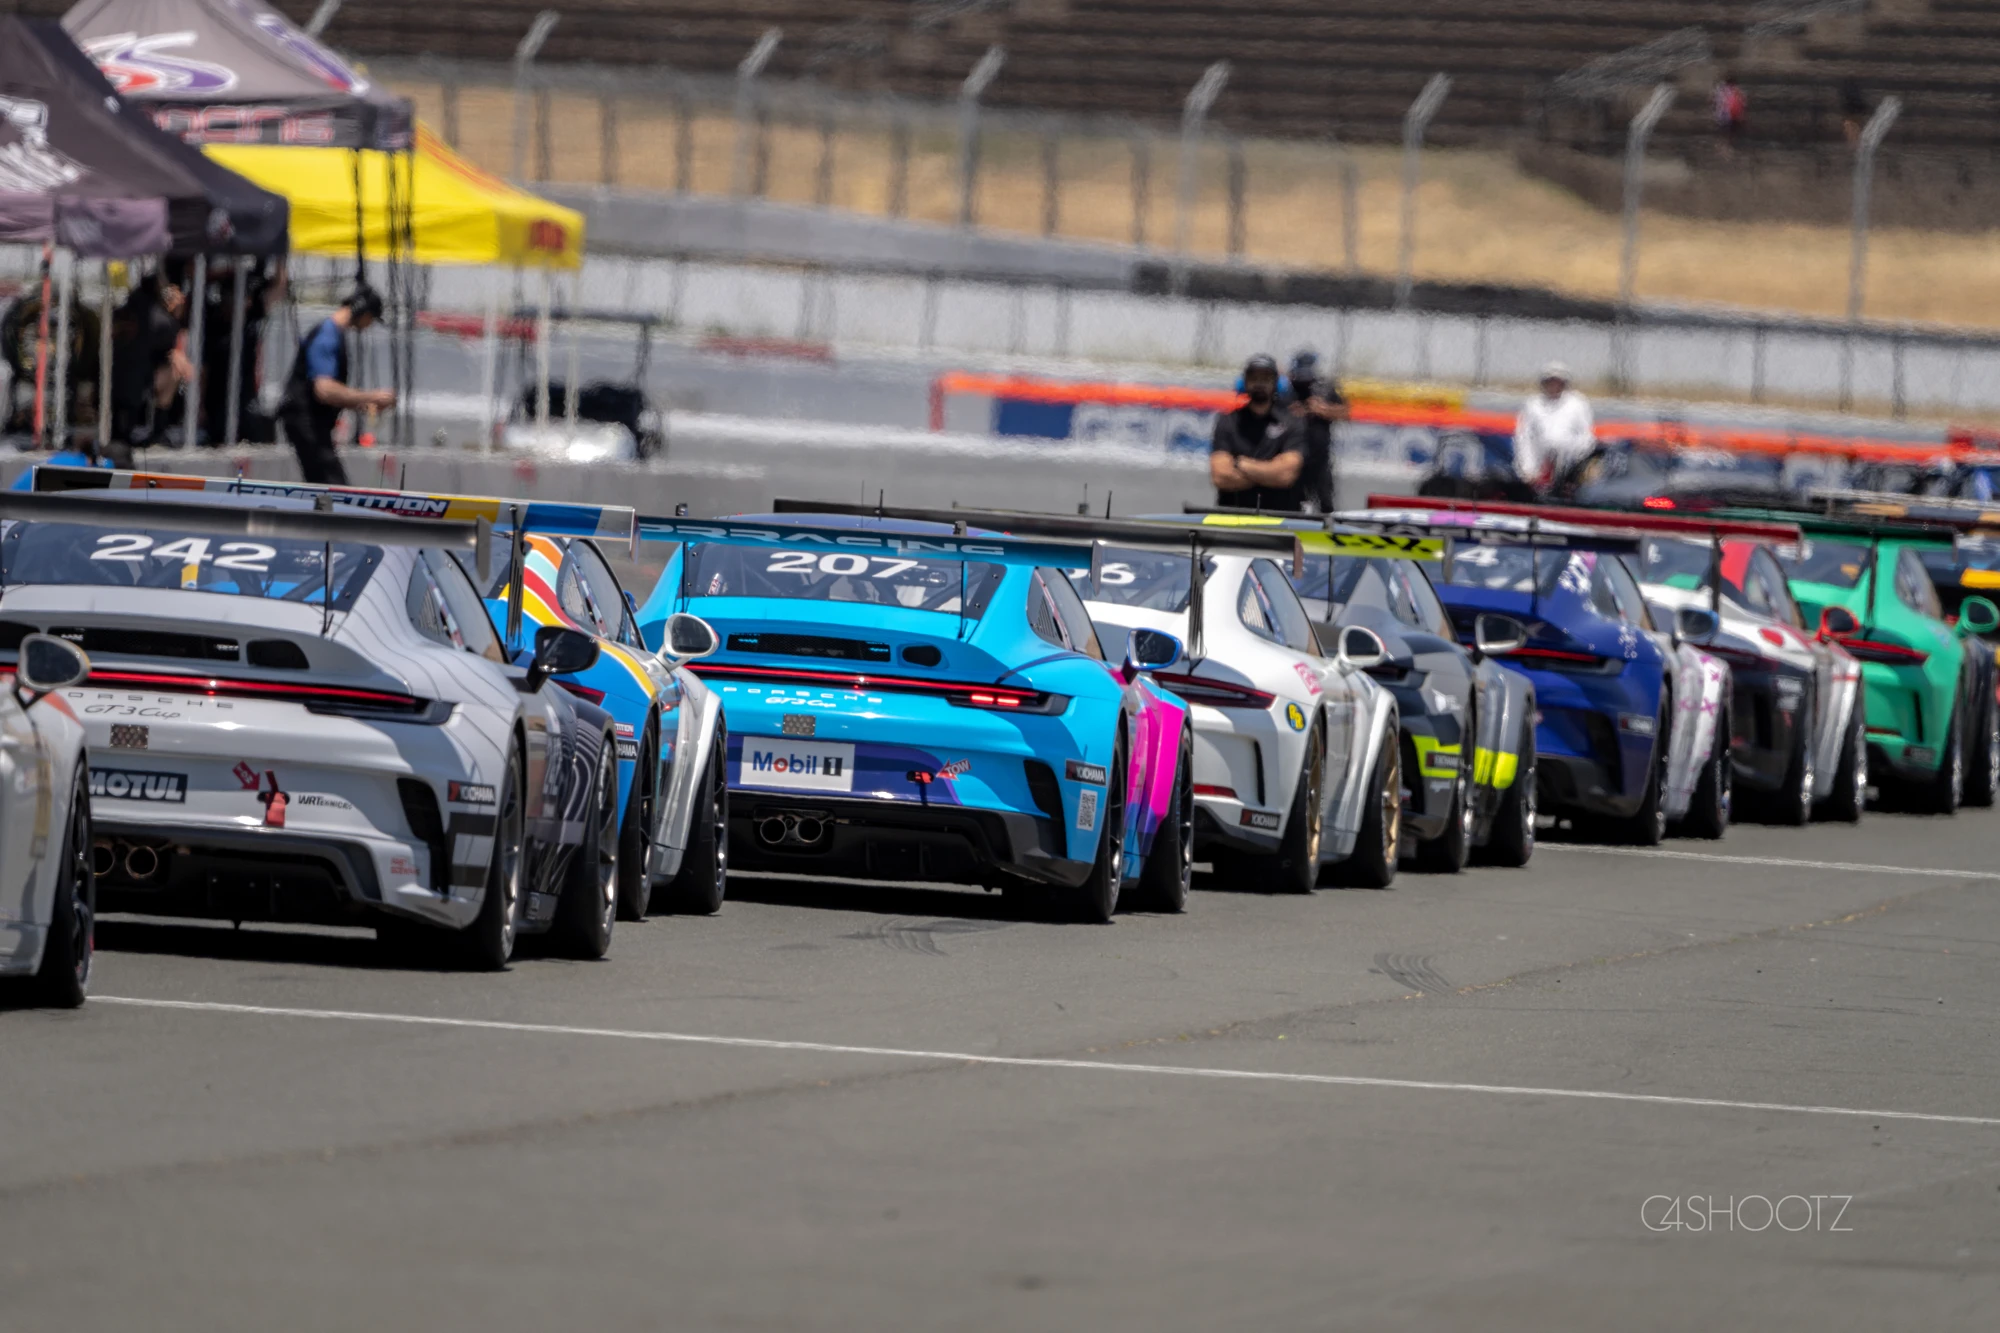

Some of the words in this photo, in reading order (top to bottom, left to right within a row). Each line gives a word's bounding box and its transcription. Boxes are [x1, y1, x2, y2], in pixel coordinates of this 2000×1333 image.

[90, 534, 277, 571] 242
[766, 551, 918, 578] 207
[67, 692, 233, 708] ORSCHE
[138, 707, 181, 719] Cup
[752, 751, 817, 775] Mobil
[825, 757, 840, 776] 1
[946, 760, 970, 776] TOW
[88, 770, 183, 800] MOTUL
